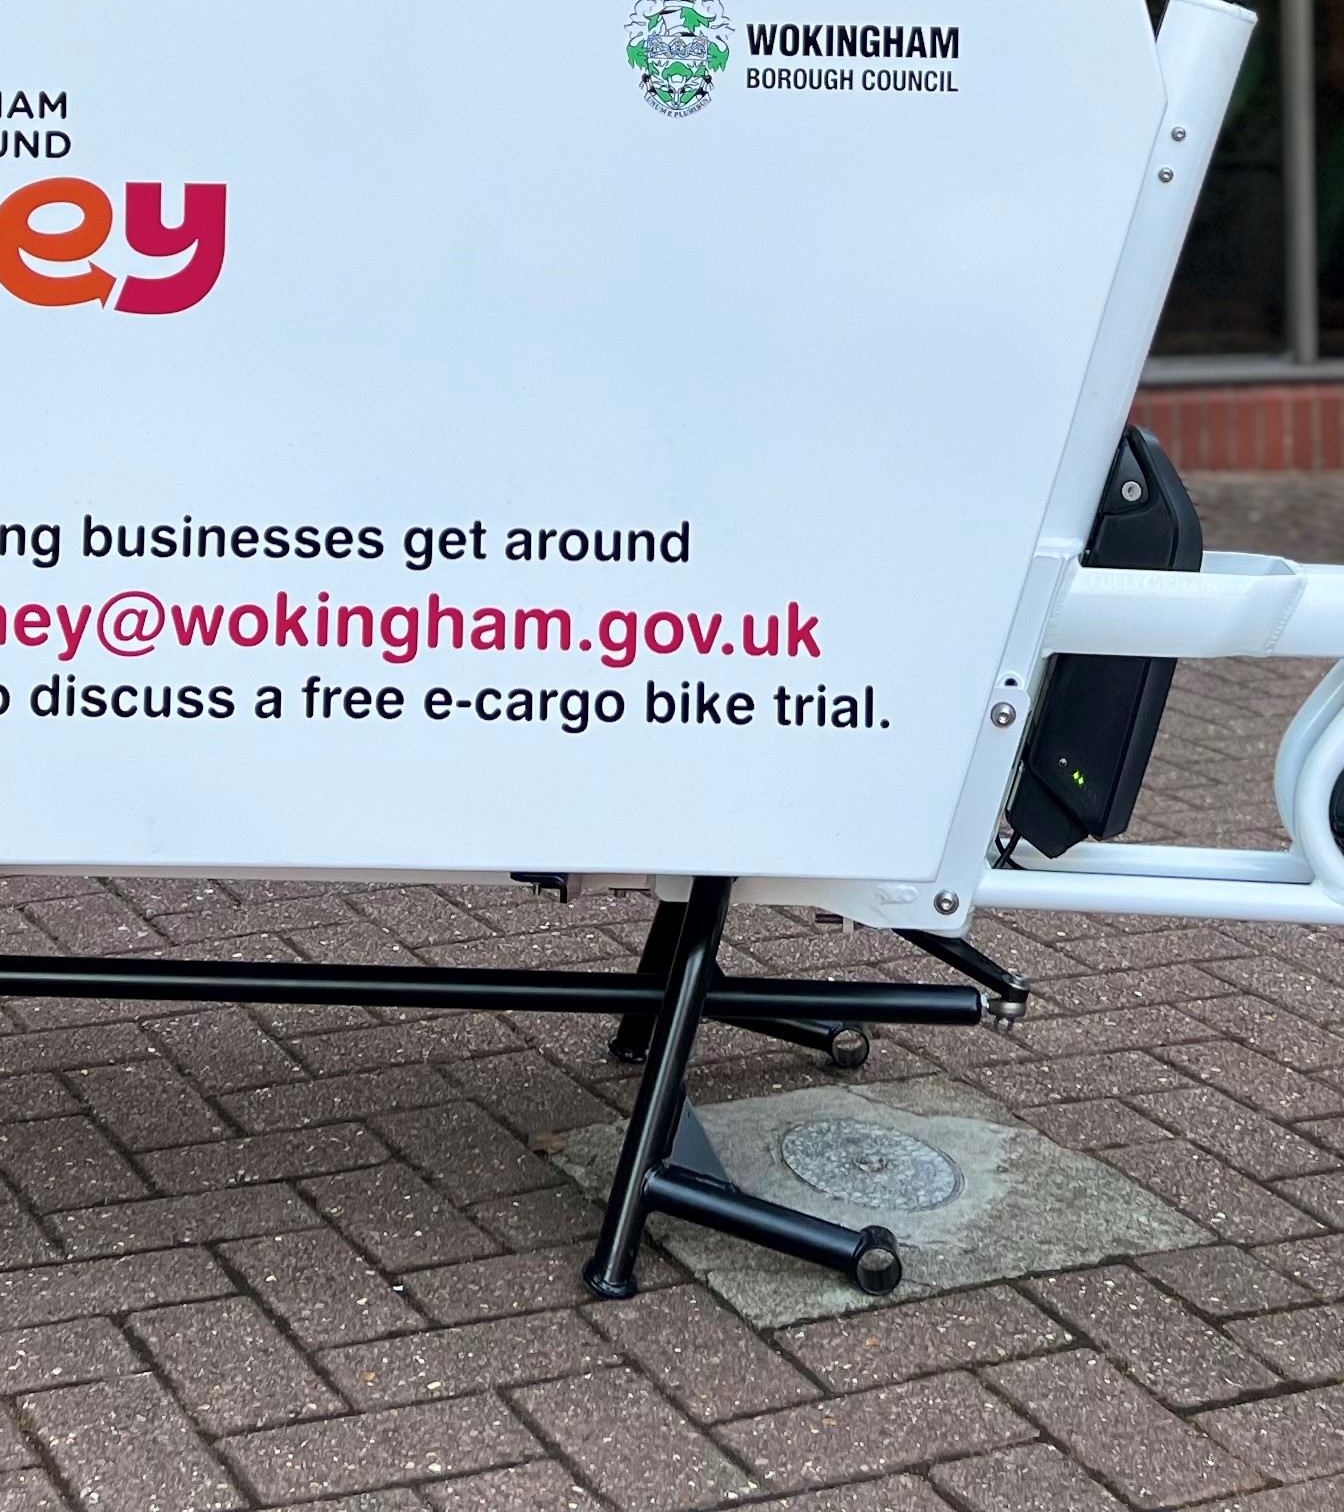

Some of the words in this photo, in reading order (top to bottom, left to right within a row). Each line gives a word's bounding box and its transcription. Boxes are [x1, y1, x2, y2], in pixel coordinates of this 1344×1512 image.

[746, 24, 959, 59] WOKINGHAM
[746, 68, 853, 91] BOROUGH
[862, 70, 959, 92] COUNCIL
[83, 514, 385, 558] businesses
[403, 520, 487, 571] get
[505, 520, 691, 564] around
[30, 674, 235, 720] discuss
[255, 685, 282, 720] a
[303, 676, 405, 720] free
[423, 683, 625, 734] e-cargo
[646, 681, 755, 727] bike
[774, 684, 890, 729] trial.
